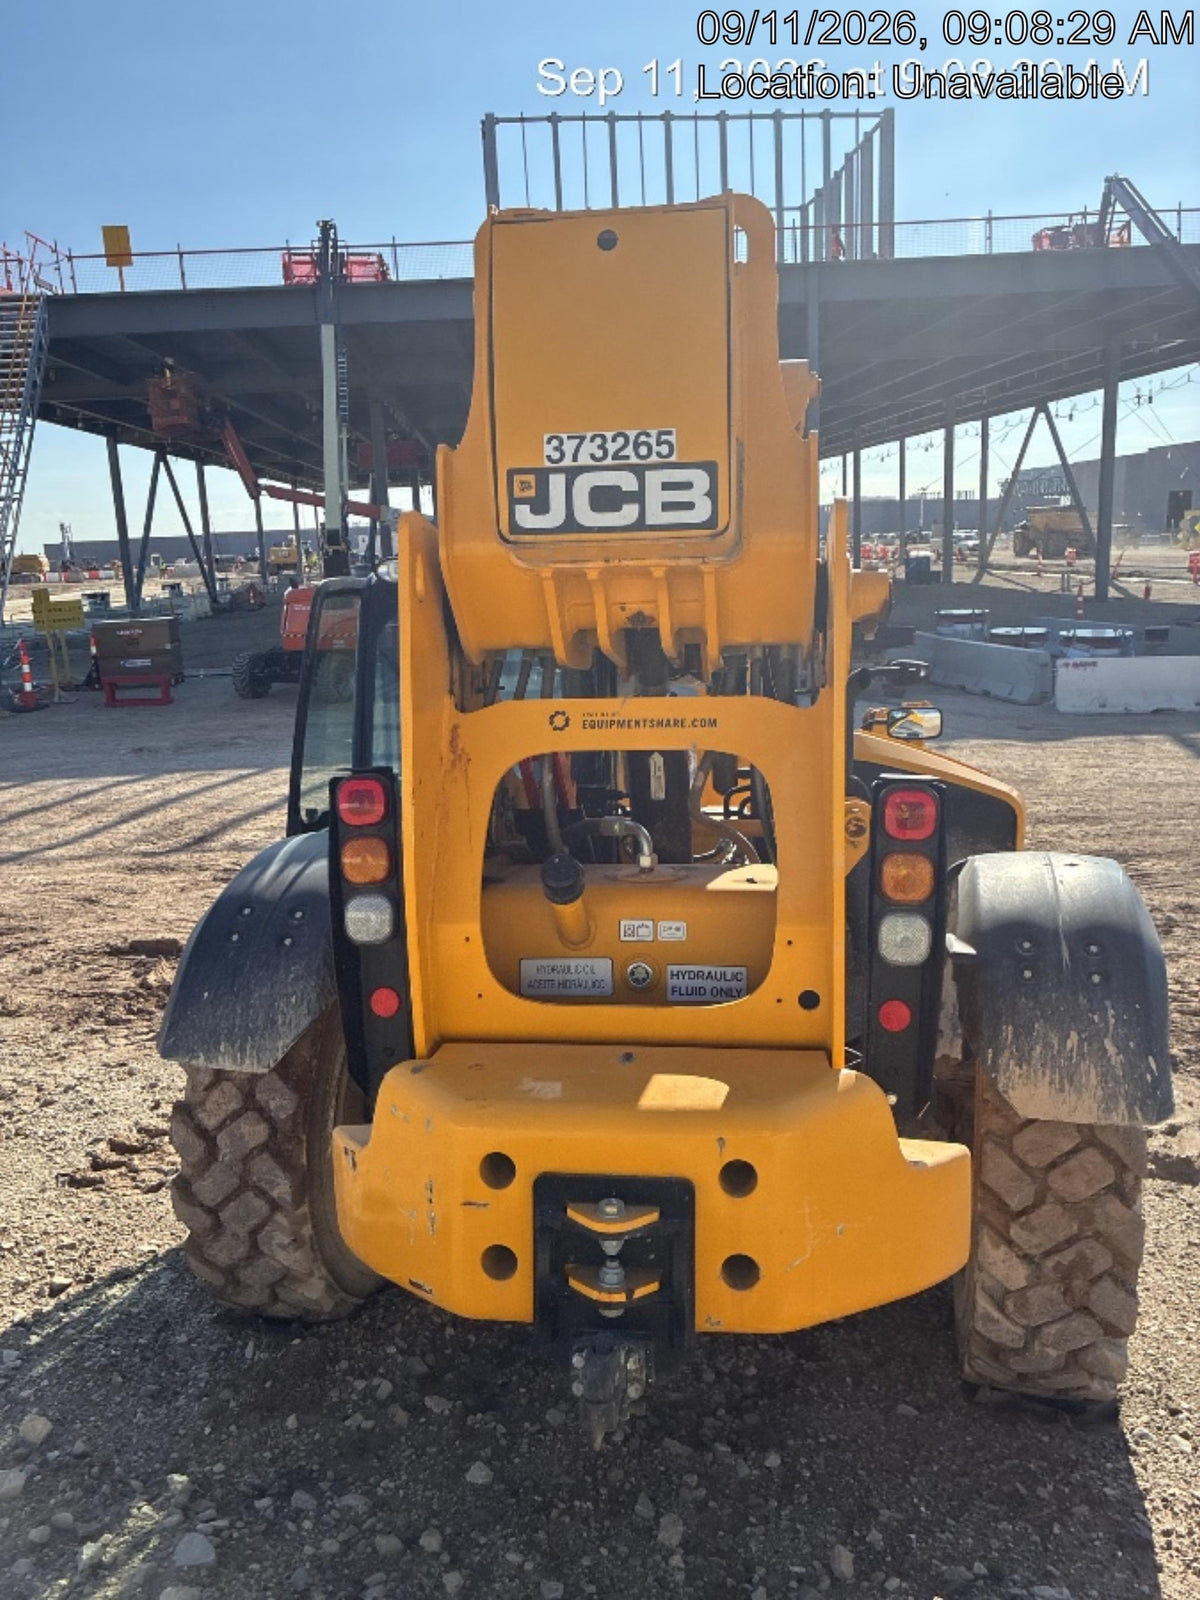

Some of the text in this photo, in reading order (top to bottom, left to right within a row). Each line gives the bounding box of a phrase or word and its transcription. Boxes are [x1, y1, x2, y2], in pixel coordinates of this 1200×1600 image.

[545, 429, 676, 465] 373265
[514, 468, 713, 529] JCB
[582, 718, 718, 730] EQUIPMENTSHARE.COM
[669, 969, 744, 982] HYDRAULIC
[671, 985, 743, 999] FLUID ONLY
